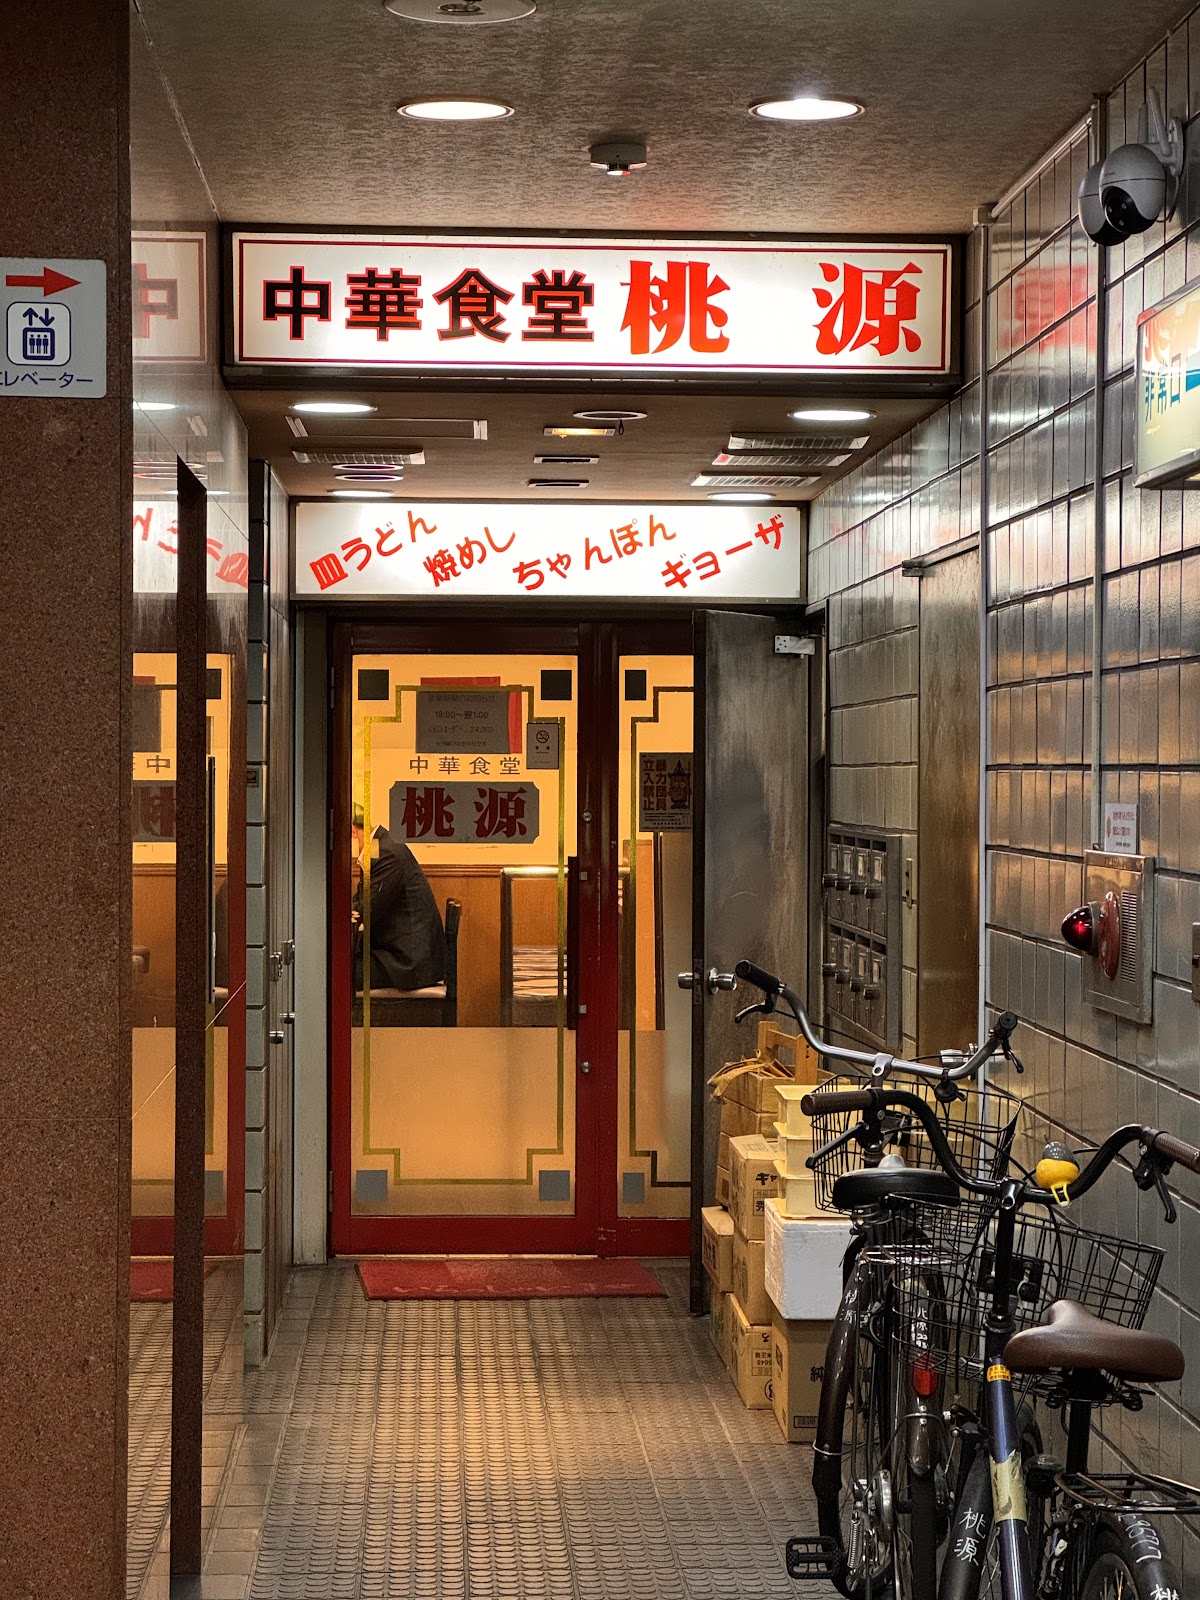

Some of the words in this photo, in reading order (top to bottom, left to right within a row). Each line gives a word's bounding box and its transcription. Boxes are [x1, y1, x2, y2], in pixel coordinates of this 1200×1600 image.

[263, 266, 594, 343] 中華食堂
[620, 260, 923, 356] 桃源
[310, 510, 437, 590] 皿うどん
[423, 526, 516, 587] 焼めし
[512, 514, 677, 591] ちゃんぽん
[661, 514, 785, 588] ギョーザ
[409, 756, 521, 775] 中華食堂
[401, 786, 527, 839] 桃源
[954, 1507, 987, 1567] 桃源
